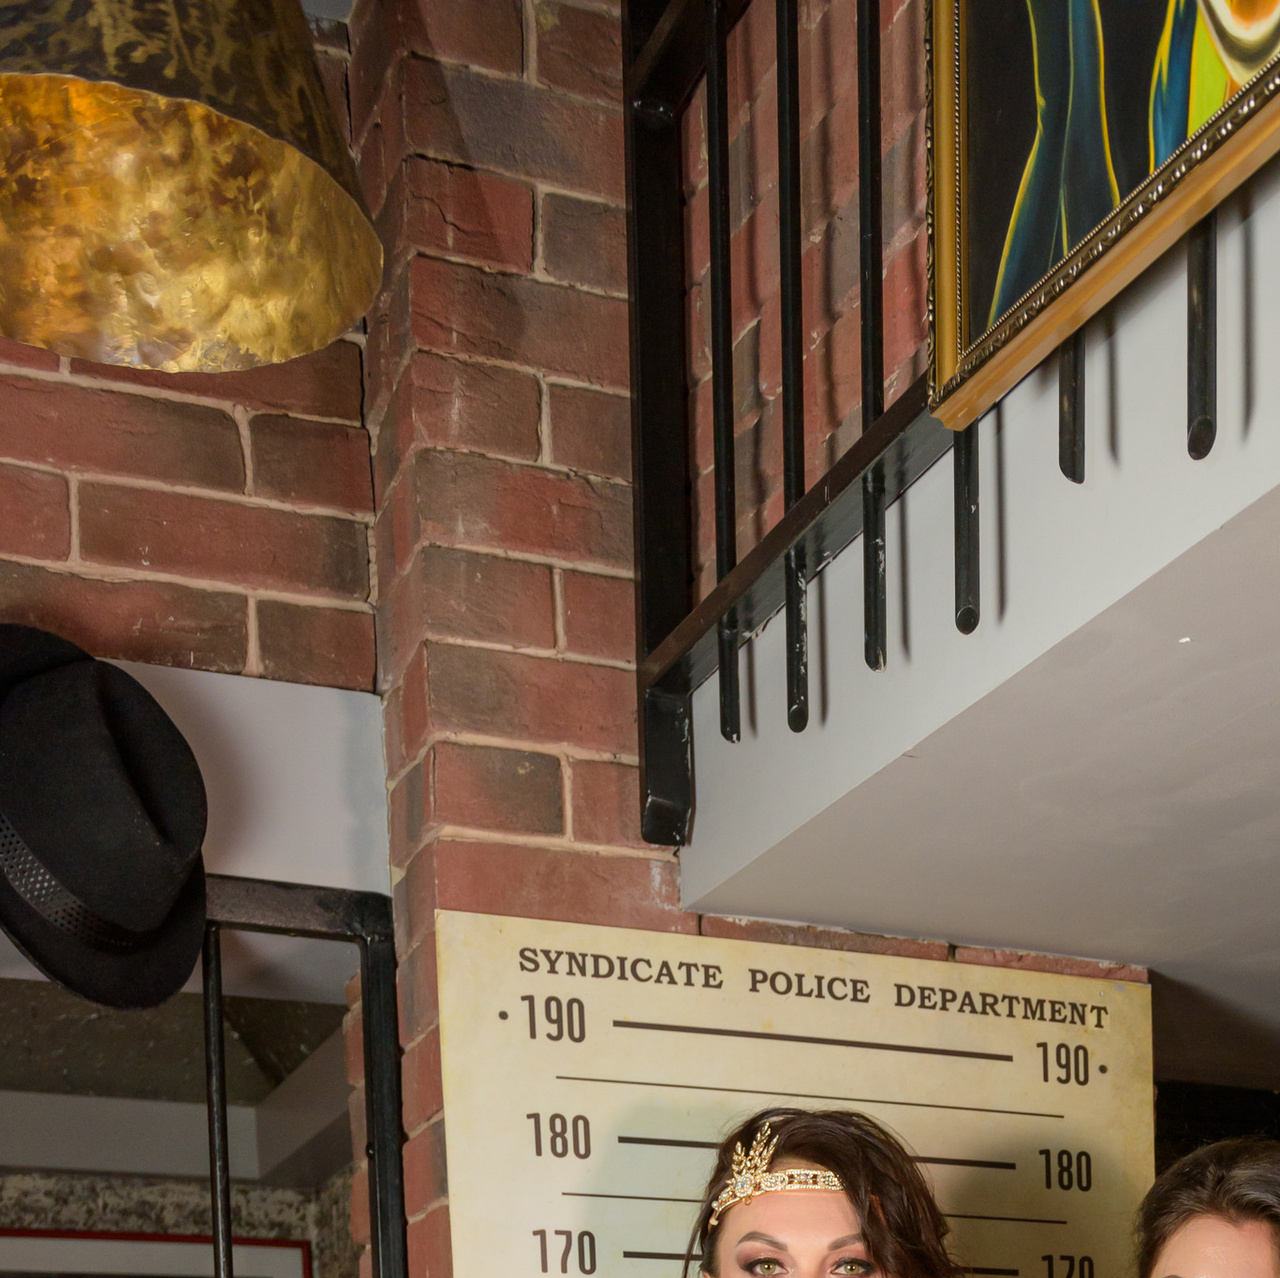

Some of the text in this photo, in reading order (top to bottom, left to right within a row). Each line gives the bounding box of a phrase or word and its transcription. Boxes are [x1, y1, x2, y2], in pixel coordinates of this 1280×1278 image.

[518, 947, 1109, 1029] SYNDICATE POLICE DEPARTMENT
[520, 995, 586, 1043] 190
[1036, 1041, 1090, 1086] 190
[526, 1112, 592, 1160] 180
[1038, 1148, 1093, 1193] 180
[532, 1229, 597, 1276] 170
